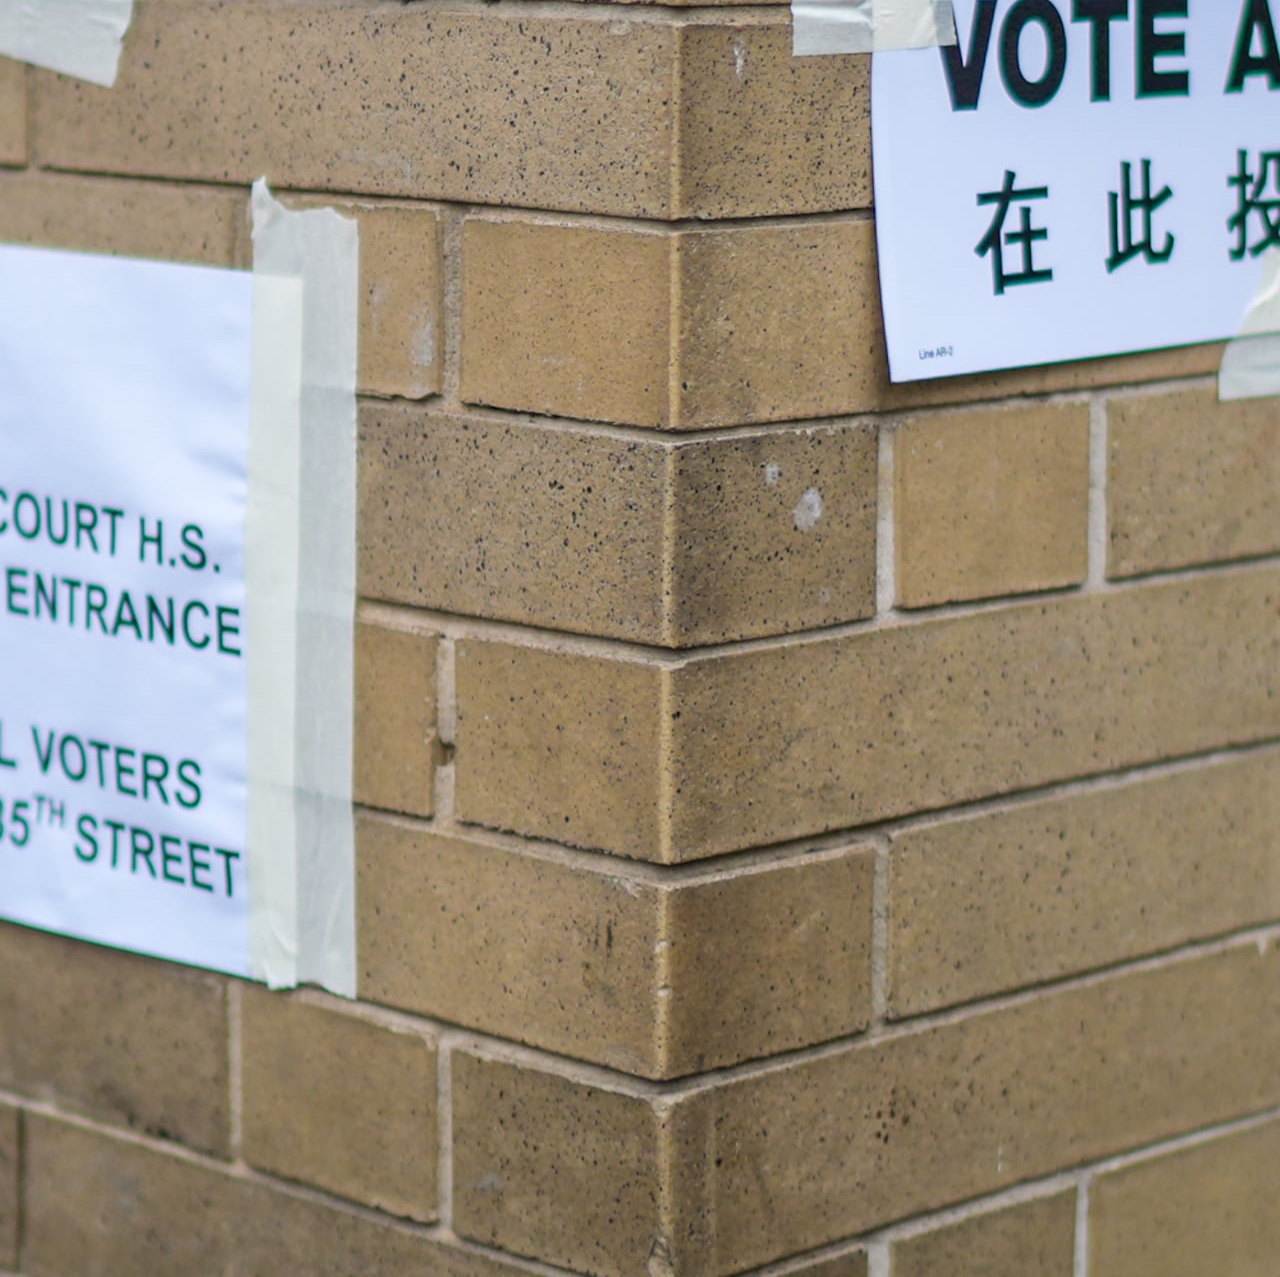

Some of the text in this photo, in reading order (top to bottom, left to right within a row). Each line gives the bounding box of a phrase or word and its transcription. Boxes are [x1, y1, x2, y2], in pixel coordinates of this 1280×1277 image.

[138, 516, 223, 574] H.S.
[4, 566, 244, 658] ENTRANCE
[30, 726, 204, 810] VOTERS
[73, 812, 242, 899] STREET
